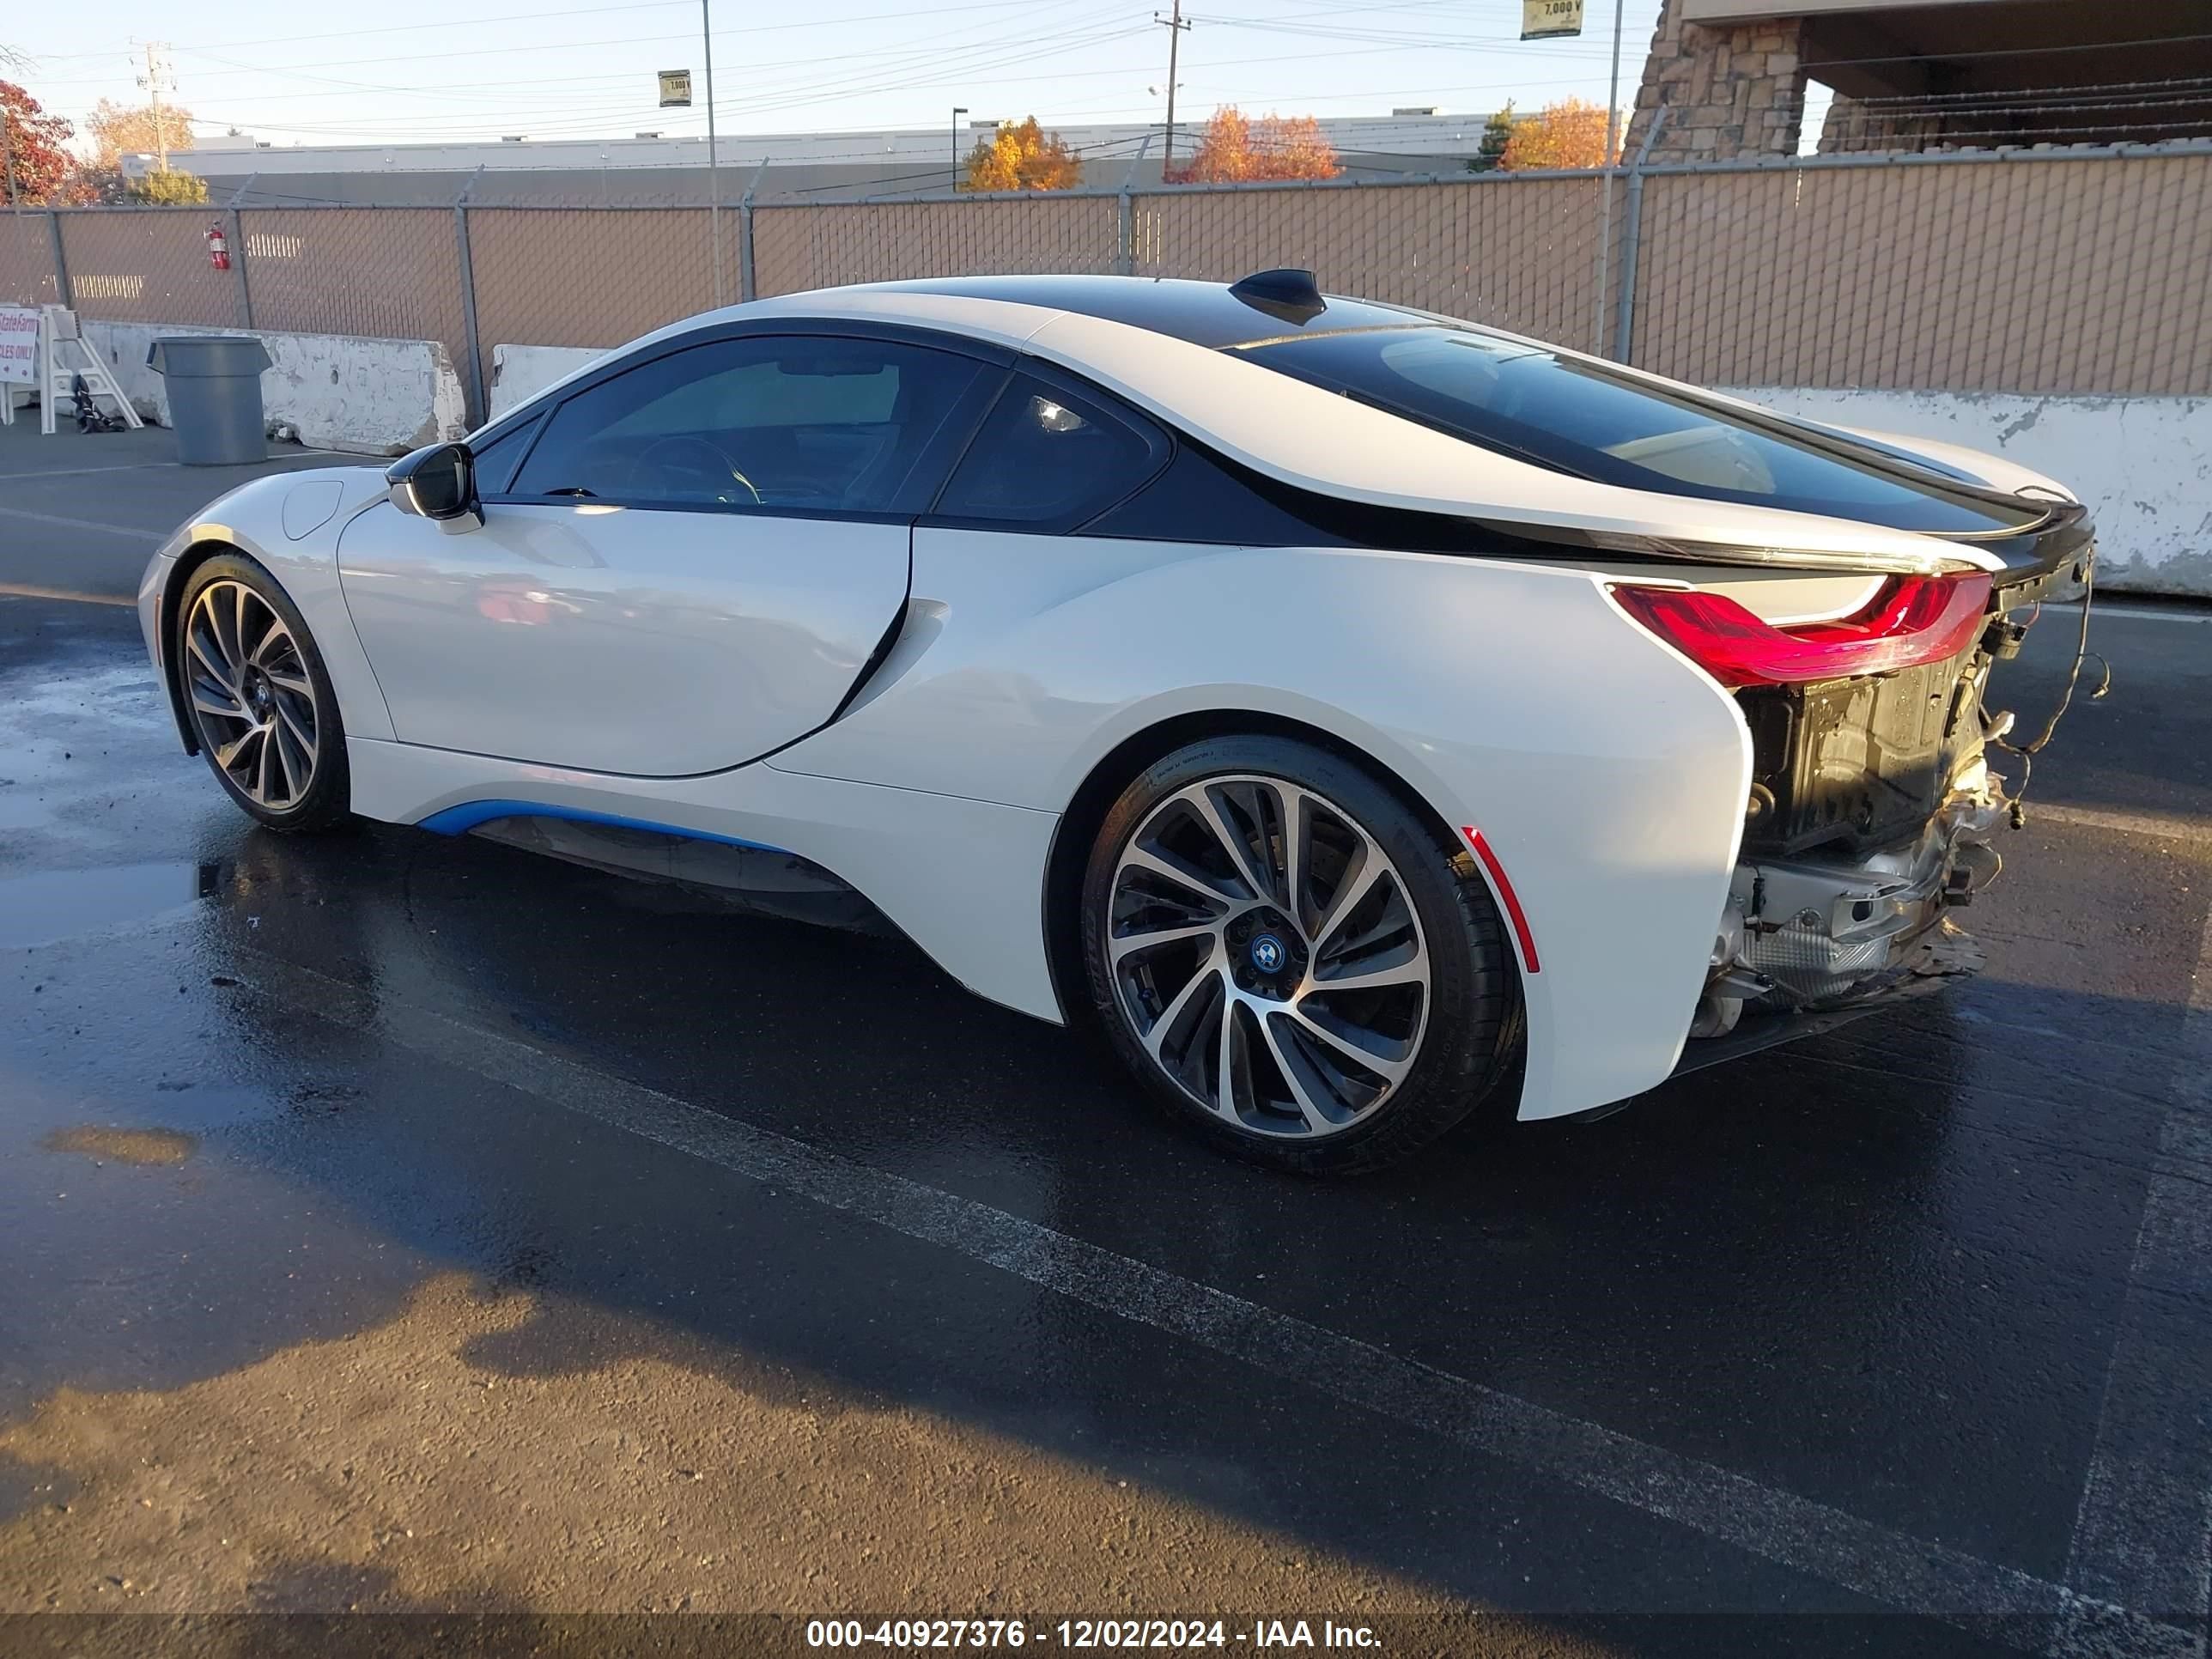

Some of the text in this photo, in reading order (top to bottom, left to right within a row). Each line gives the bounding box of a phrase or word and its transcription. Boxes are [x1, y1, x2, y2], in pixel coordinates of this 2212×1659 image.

[1545, 1, 1572, 15] 7,000
[670, 80, 686, 89] 7,000
[15, 344, 33, 361] ONLY
